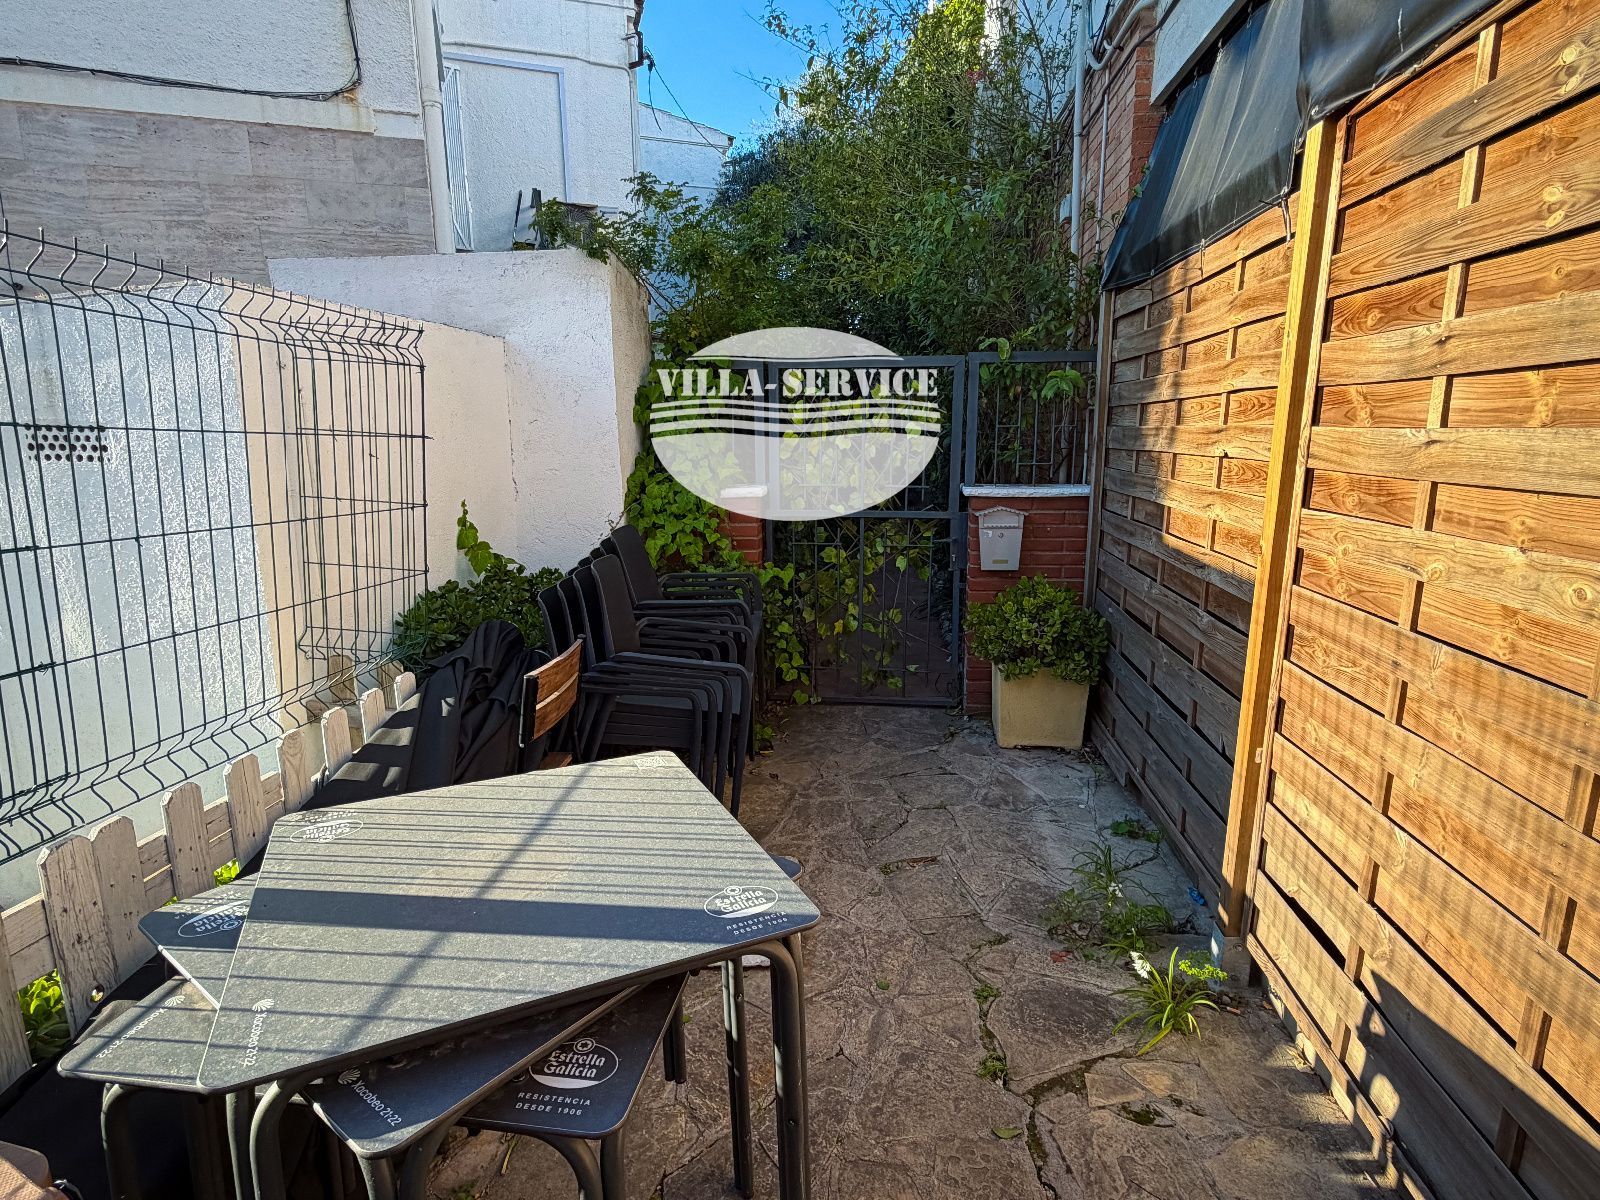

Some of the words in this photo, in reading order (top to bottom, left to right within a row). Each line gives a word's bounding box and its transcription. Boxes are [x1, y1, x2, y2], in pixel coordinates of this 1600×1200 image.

[715, 890, 763, 907] Estrella
[721, 897, 766, 912] Galicia
[726, 911, 786, 930] RESISTENCIA
[733, 924, 764, 935] DESDE
[548, 1050, 606, 1067] Estrella
[543, 1061, 597, 1078] Galicia
[517, 1092, 591, 1106] RESISTENCIA
[515, 1102, 553, 1113] DESDE
[557, 1107, 583, 1116] 1906
